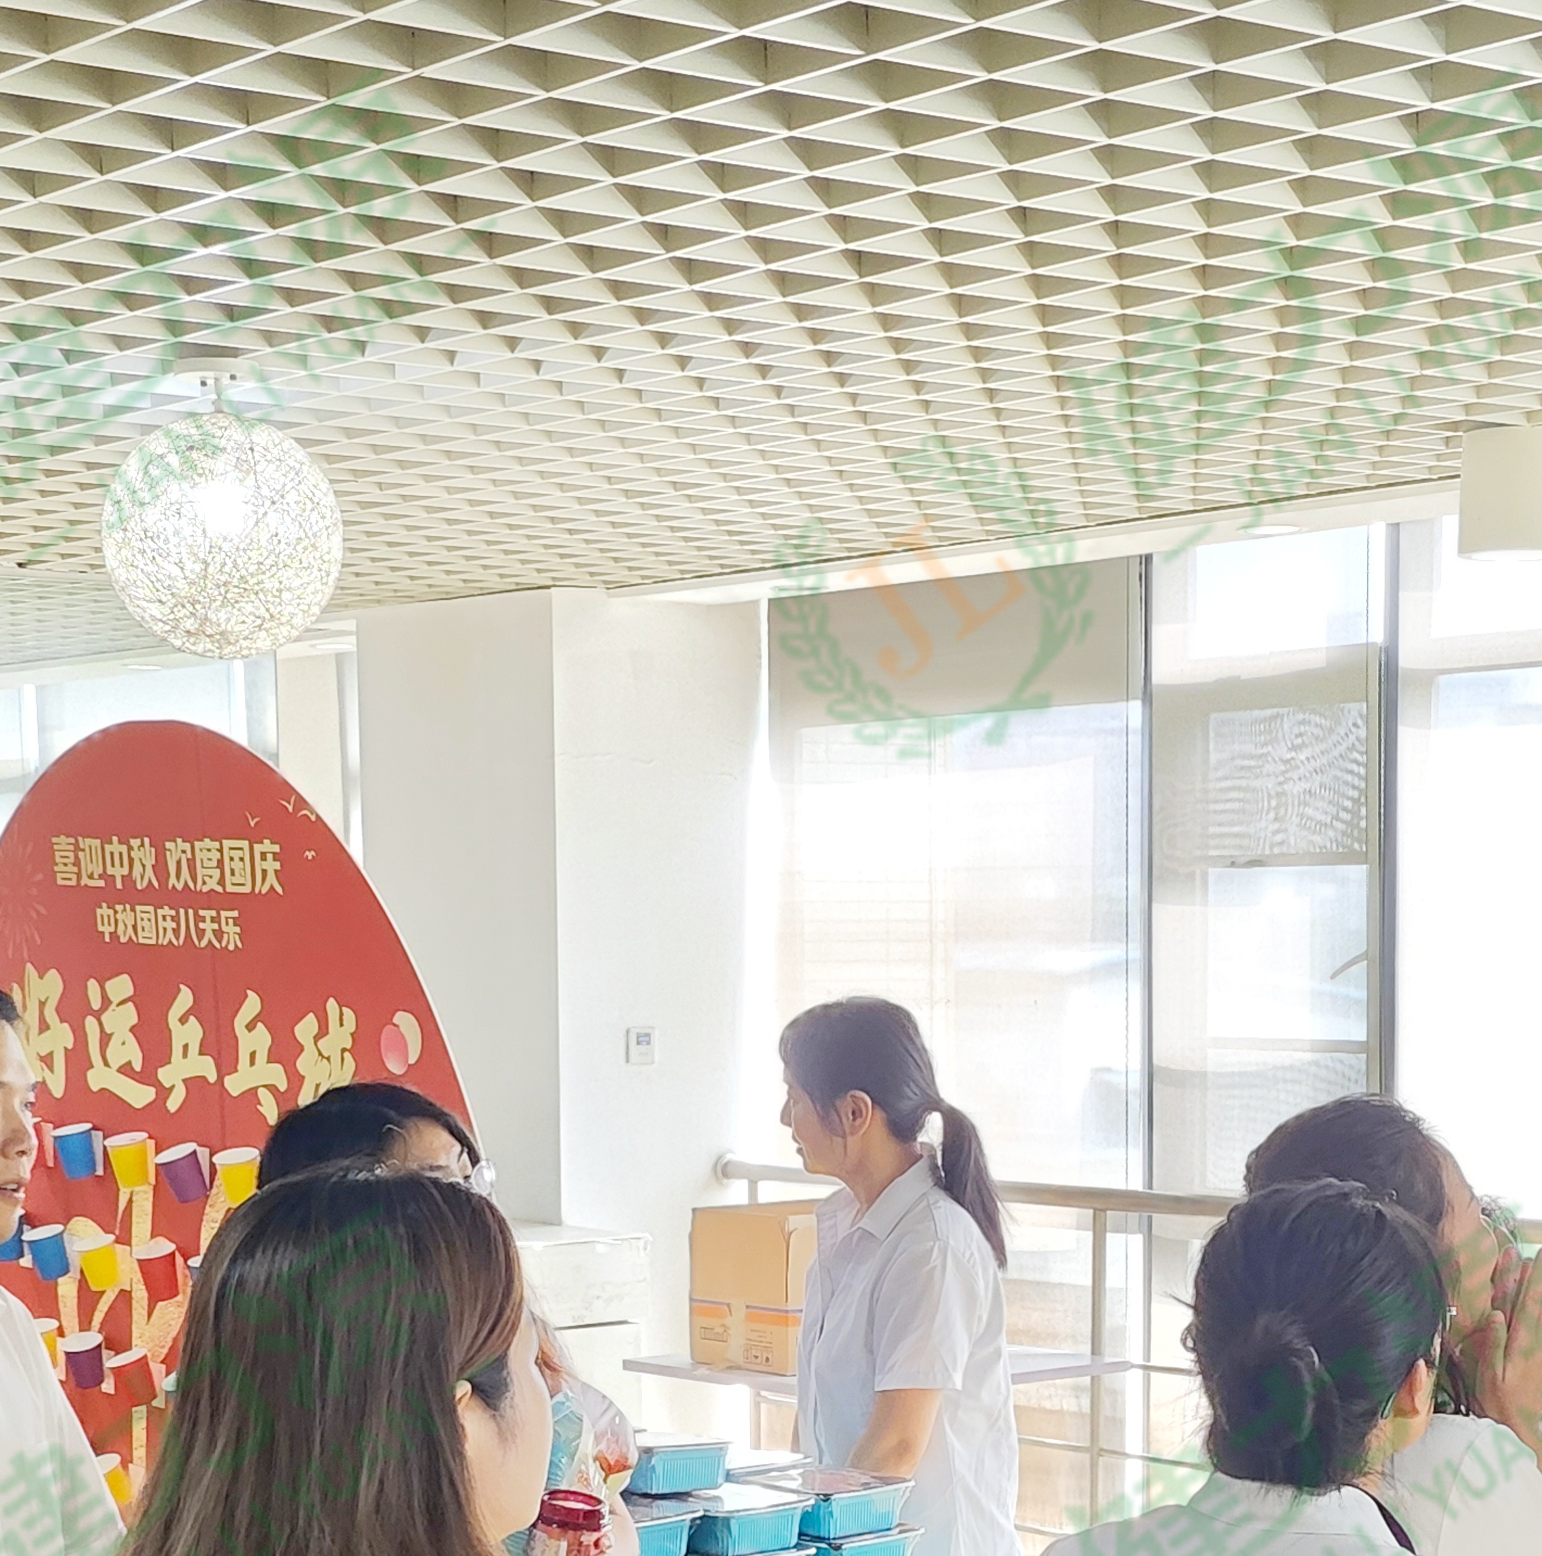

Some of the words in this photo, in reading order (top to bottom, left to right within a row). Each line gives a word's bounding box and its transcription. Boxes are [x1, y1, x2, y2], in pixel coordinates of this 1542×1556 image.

[52, 835, 159, 891] 喜迎中秋
[166, 836, 284, 896] 欢度国庆
[96, 902, 243, 951] 中秋国庆八天乐
[12, 961, 358, 1126] 好运乒乓球
